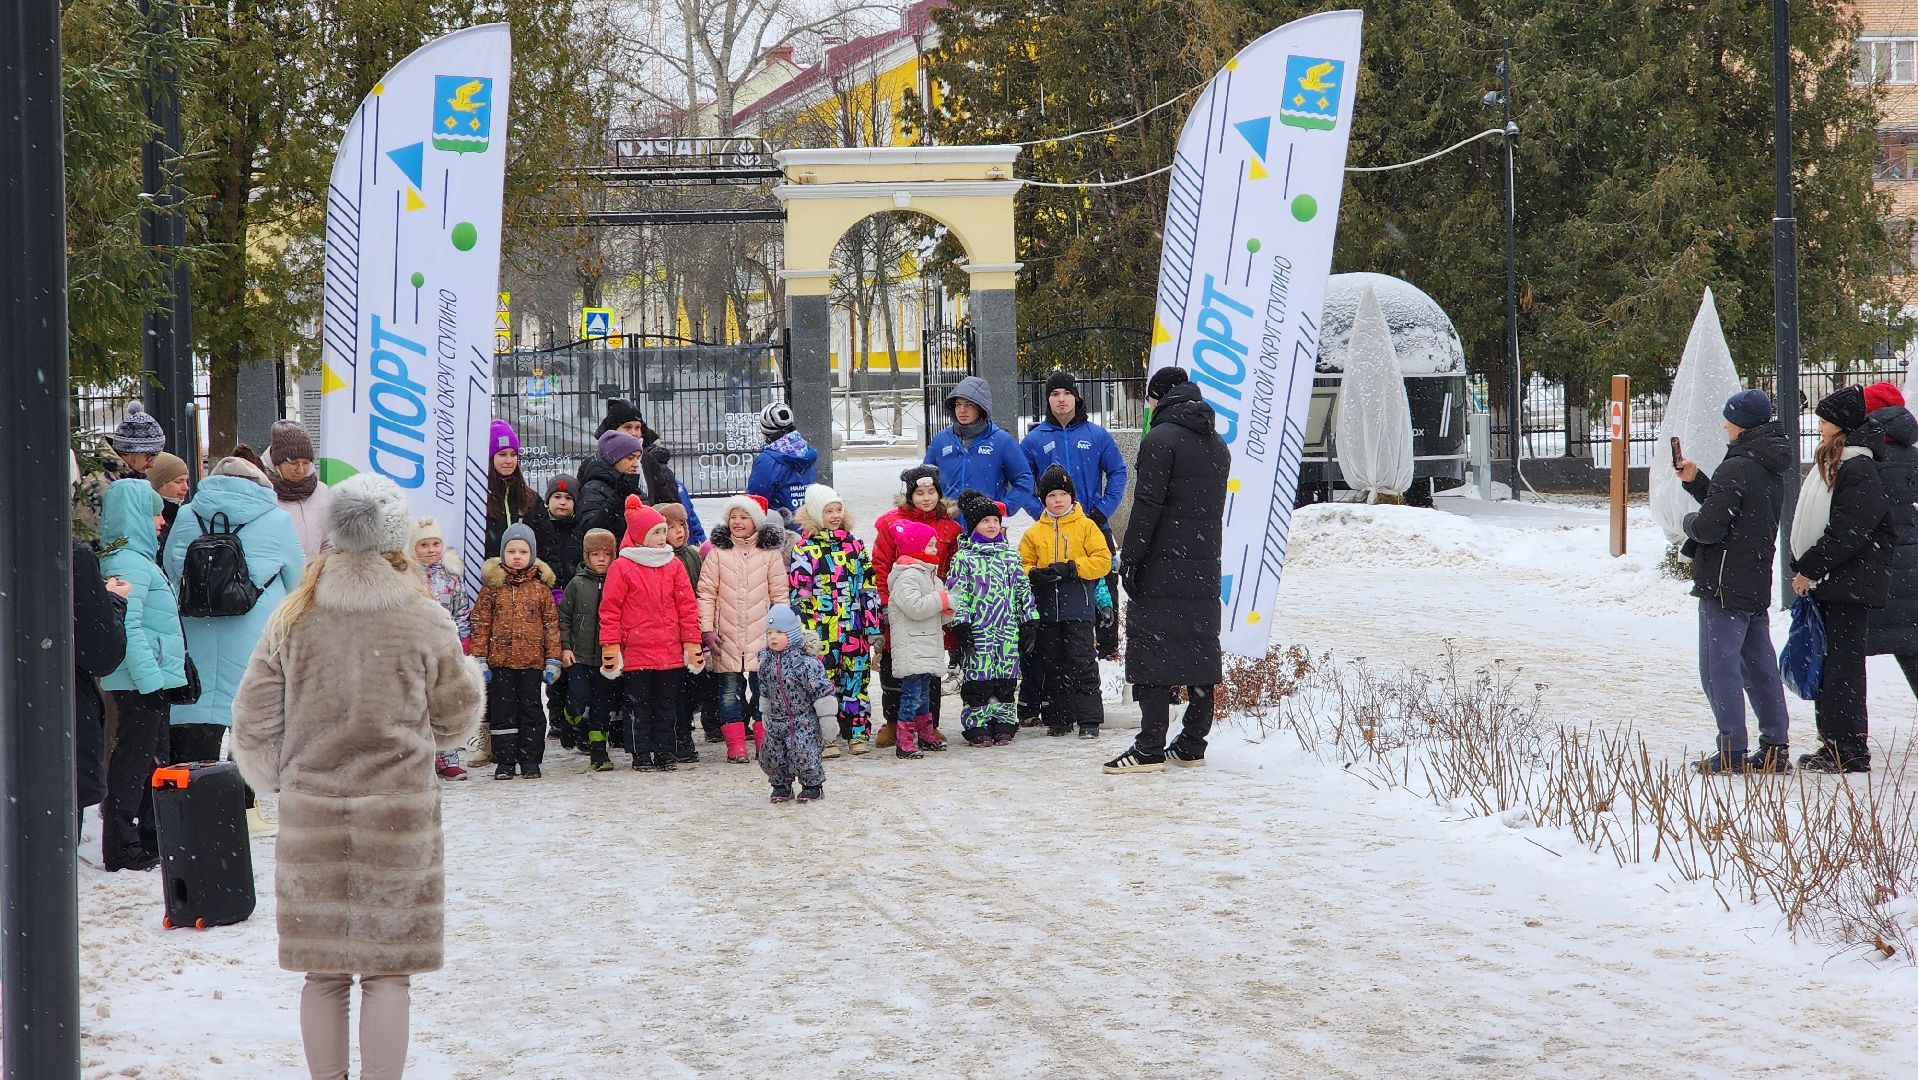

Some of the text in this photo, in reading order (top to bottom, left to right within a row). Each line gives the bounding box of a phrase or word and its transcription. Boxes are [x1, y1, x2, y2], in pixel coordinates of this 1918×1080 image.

[1246, 255, 1292, 463] ГОРОДСКОЙ ОКРУГ СТУПИНО
[368, 313, 427, 489] СПОРТ
[433, 288, 457, 504] ГОРОДСКОЙ ОКРУГ СТУПИНО
[518, 445, 548, 455] ОРОД
[698, 453, 753, 469] СПОР
[522, 468, 571, 479] ОБЛЕСТИ
[710, 469, 752, 482] ступи
